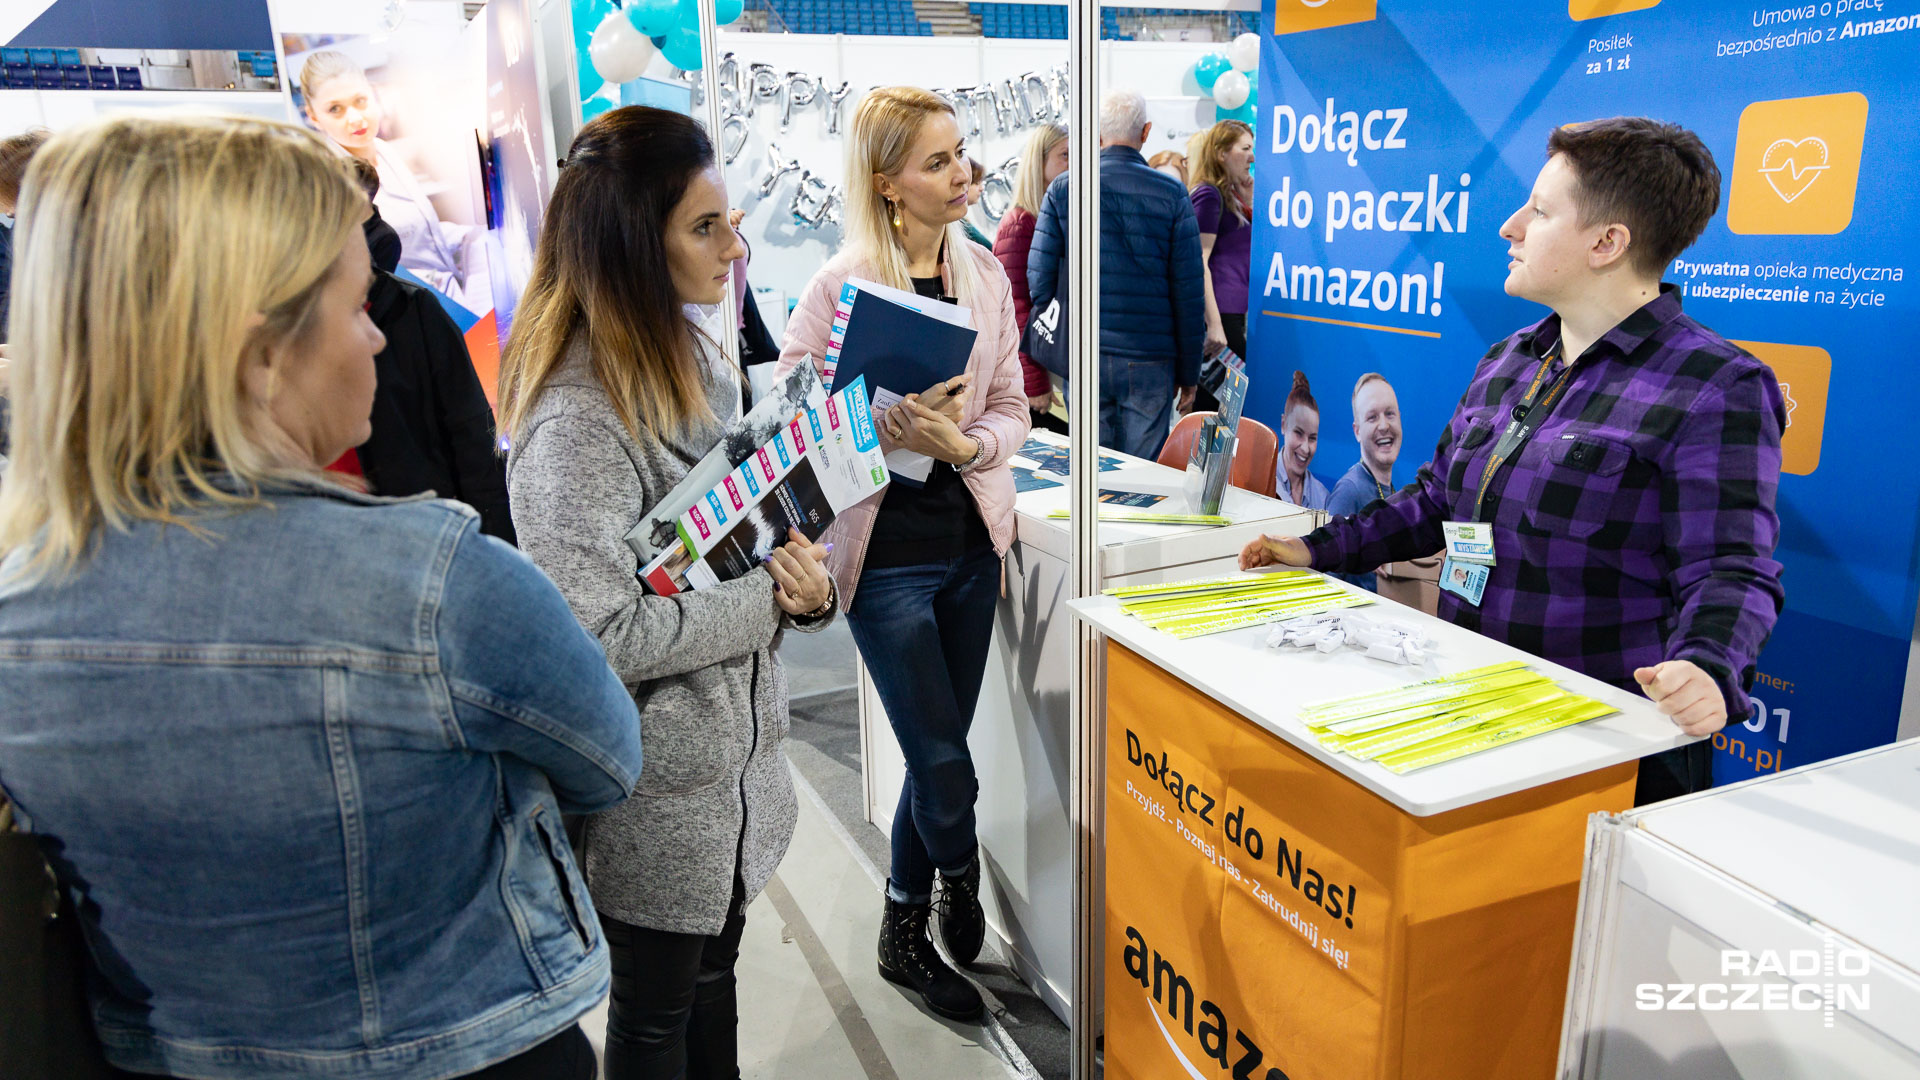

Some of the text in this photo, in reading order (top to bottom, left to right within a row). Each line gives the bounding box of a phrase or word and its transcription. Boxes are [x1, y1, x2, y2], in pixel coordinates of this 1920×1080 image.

[1716, 14, 1920, 57] bezpośrednio z Amazon
[1752, 4, 1815, 27] Umowa
[1820, 3, 1831, 17] o
[1588, 32, 1634, 54] Posiłek
[1586, 54, 1631, 75] za 1 zł
[1272, 97, 1408, 167] Dołącz
[1268, 173, 1471, 243] do paczki
[1263, 252, 1444, 317] Amazon!
[1674, 259, 1903, 284] Prywatna opieka medyczna
[1682, 281, 1885, 309] i ubezpieczenie na życie
[851, 382, 873, 443] PREZENTACJE
[1517, 425, 1529, 438] WFS
[809, 508, 820, 524] DGS
[1756, 671, 1795, 694] mer:
[1742, 696, 1791, 744] 01
[1712, 732, 1782, 773] on.pl
[1126, 728, 1357, 930] Dołącz do Nas!
[1126, 779, 1166, 824] Przyjdź
[1176, 818, 1216, 865] Poznaj
[1218, 854, 1241, 881] nas
[1252, 878, 1319, 950] Zatrudnij
[1321, 936, 1349, 970] się!
